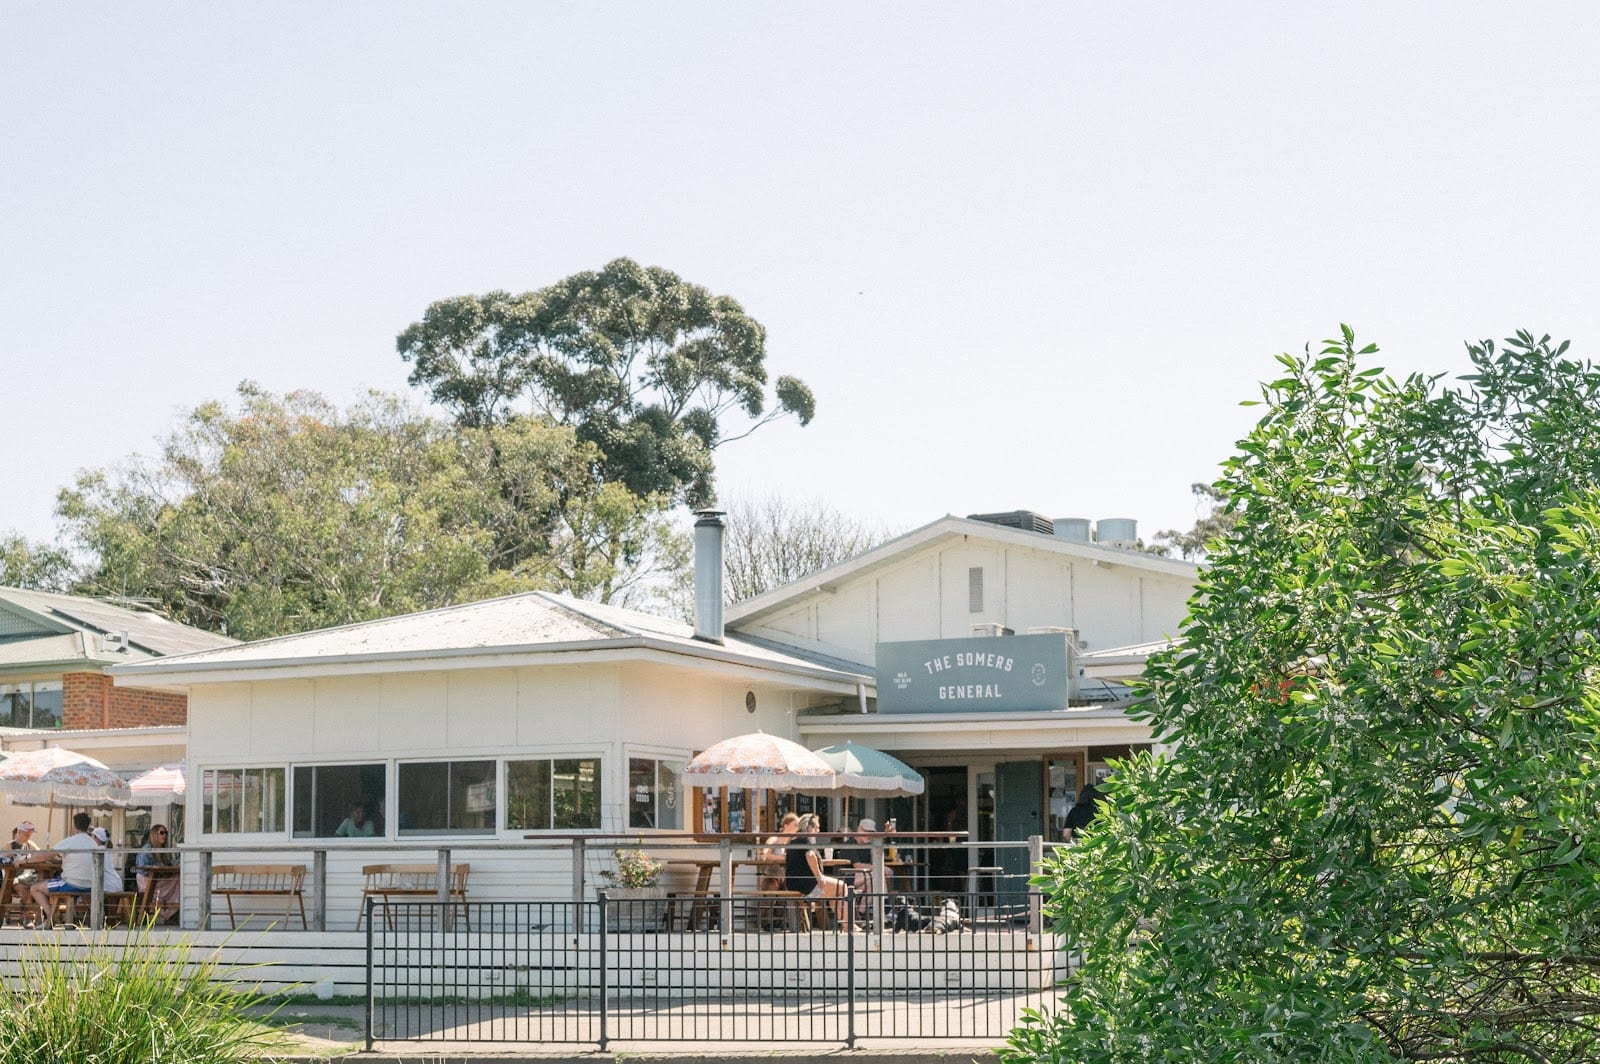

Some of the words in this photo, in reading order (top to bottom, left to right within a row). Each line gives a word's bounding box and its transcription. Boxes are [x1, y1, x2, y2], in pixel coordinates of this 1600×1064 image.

[925, 656, 952, 675] THE
[956, 652, 1014, 672] SOMERS
[939, 684, 1002, 700] GENERAL
